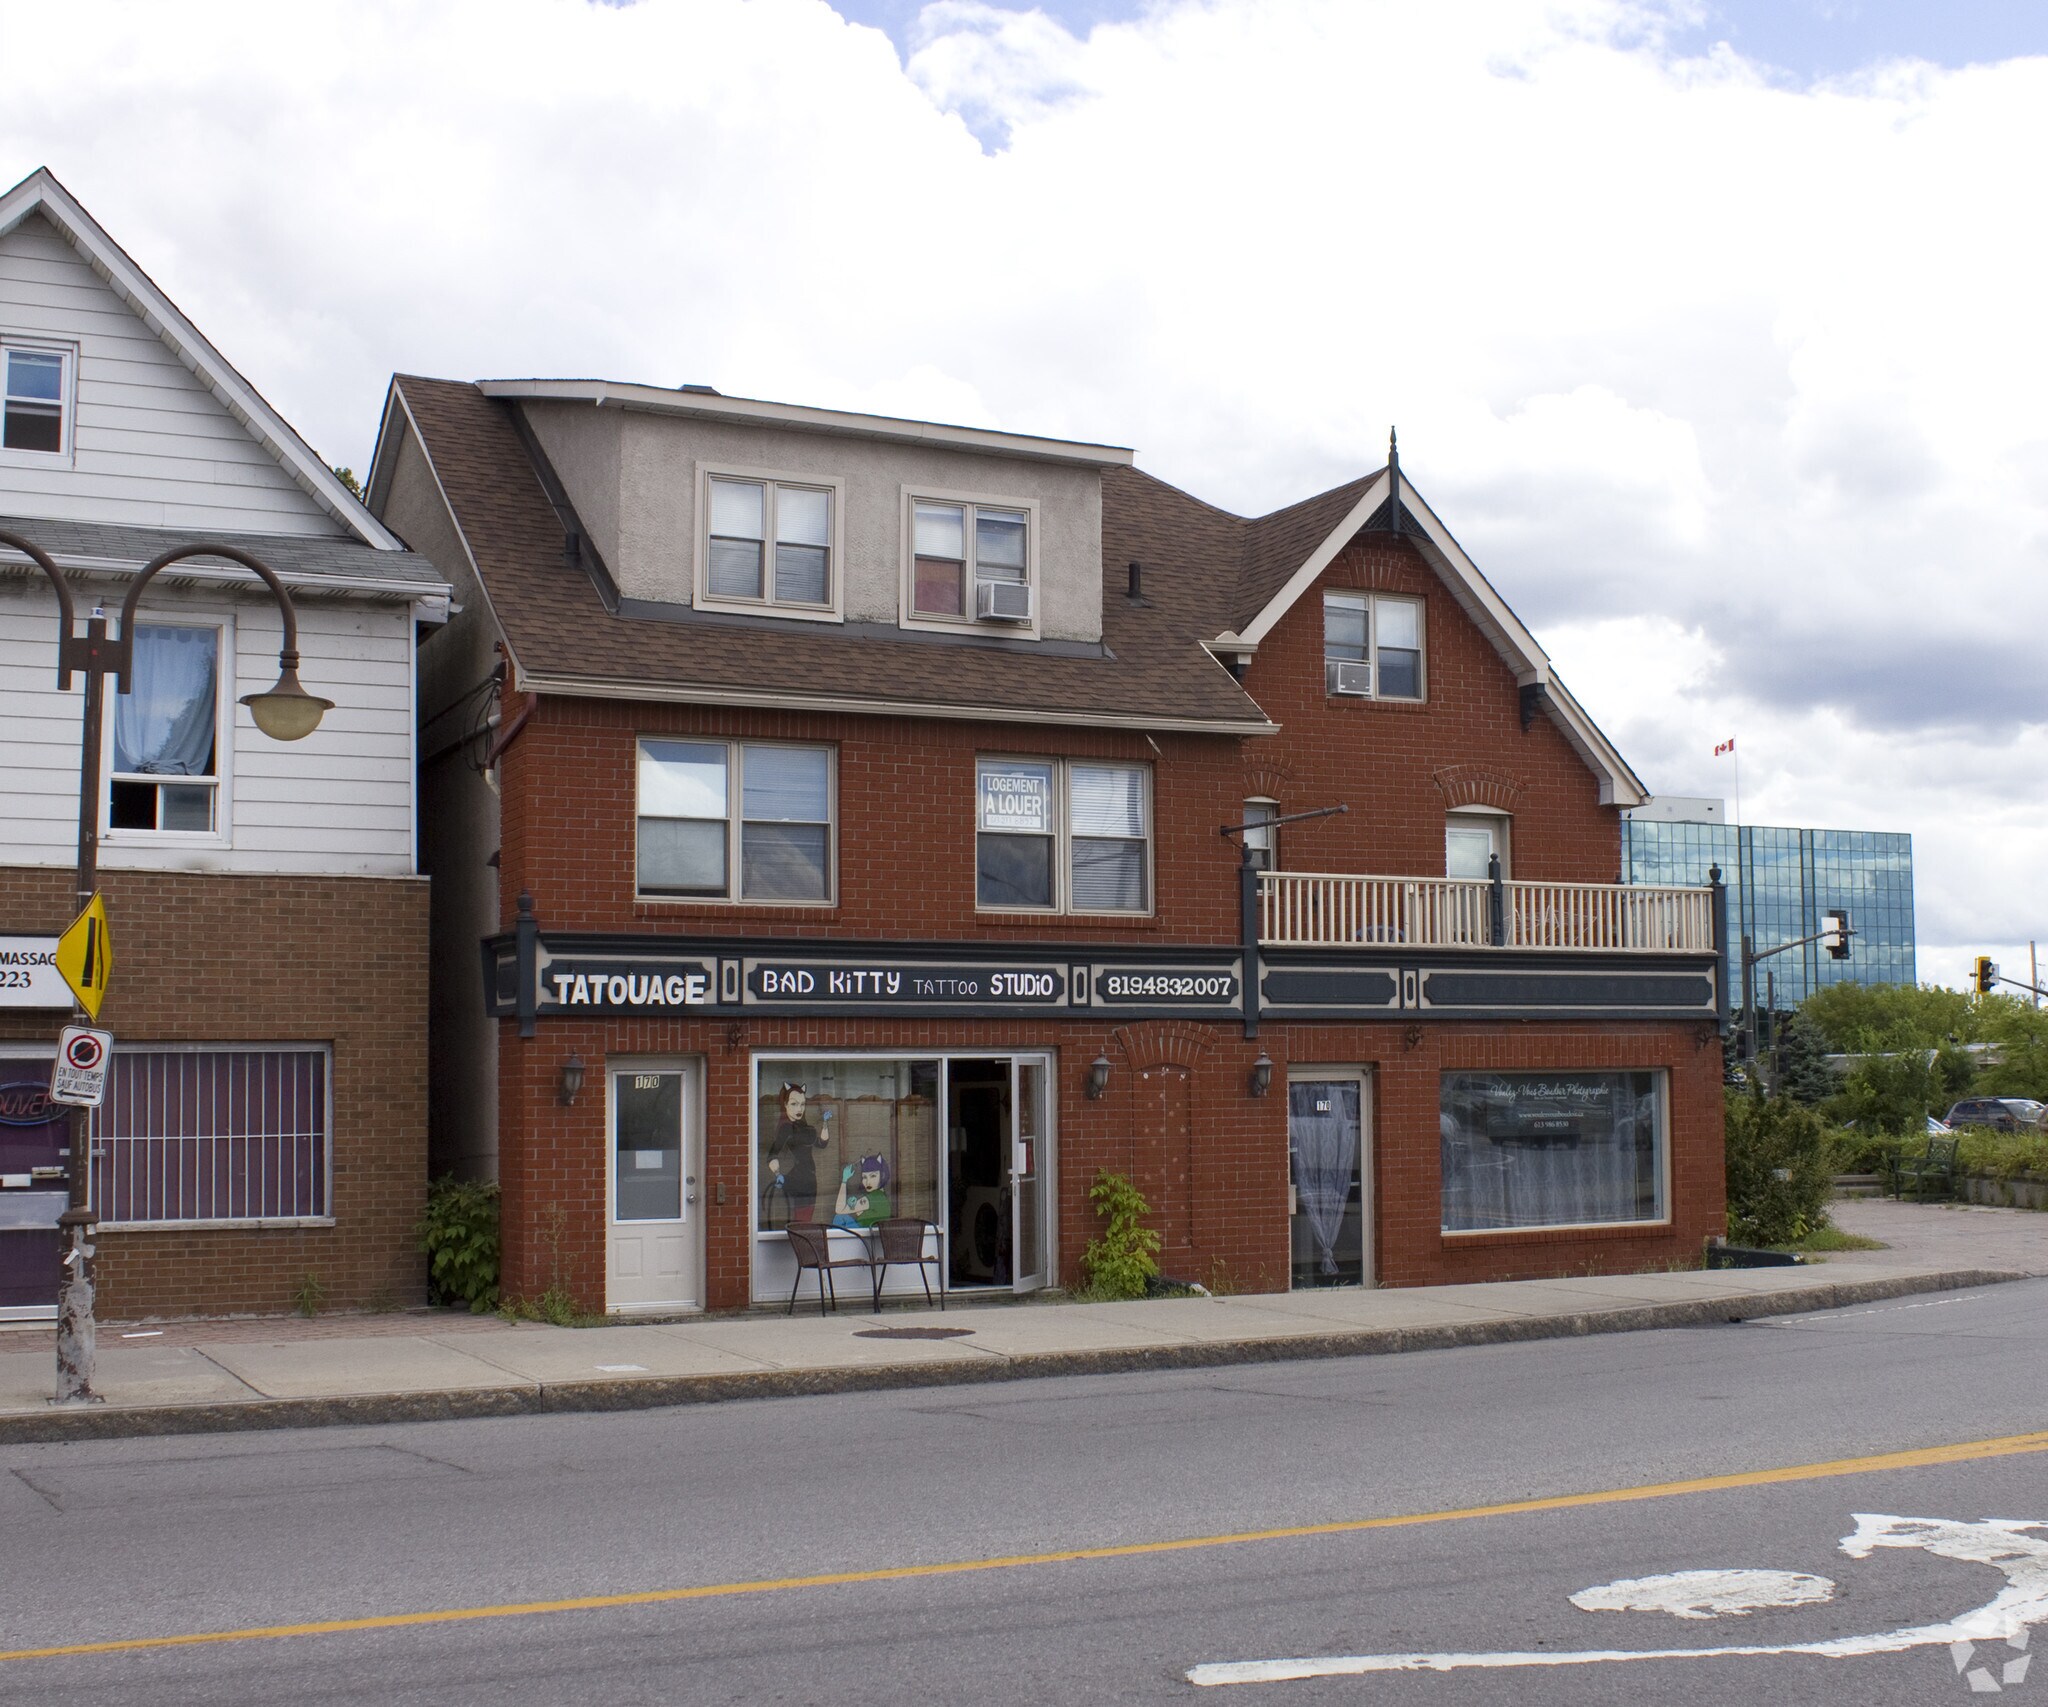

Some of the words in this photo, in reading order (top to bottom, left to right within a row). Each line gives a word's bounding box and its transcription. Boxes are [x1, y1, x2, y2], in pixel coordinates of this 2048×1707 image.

[987, 777, 1040, 794] LOGEMENT
[985, 791, 996, 814] A
[998, 793, 1042, 816] LOUER
[0, 952, 56, 966] MASSAG
[553, 974, 706, 1005] TATOUAGE
[763, 970, 815, 993] BAD
[913, 979, 978, 995] TATTOO
[58, 1066, 67, 1077] EN
[68, 1067, 83, 1079] TOUT
[84, 1070, 103, 1082] TEMPS
[635, 1076, 659, 1088] 170
[57, 1078, 72, 1089] SAUF
[73, 1081, 101, 1094] AUTOBUS
